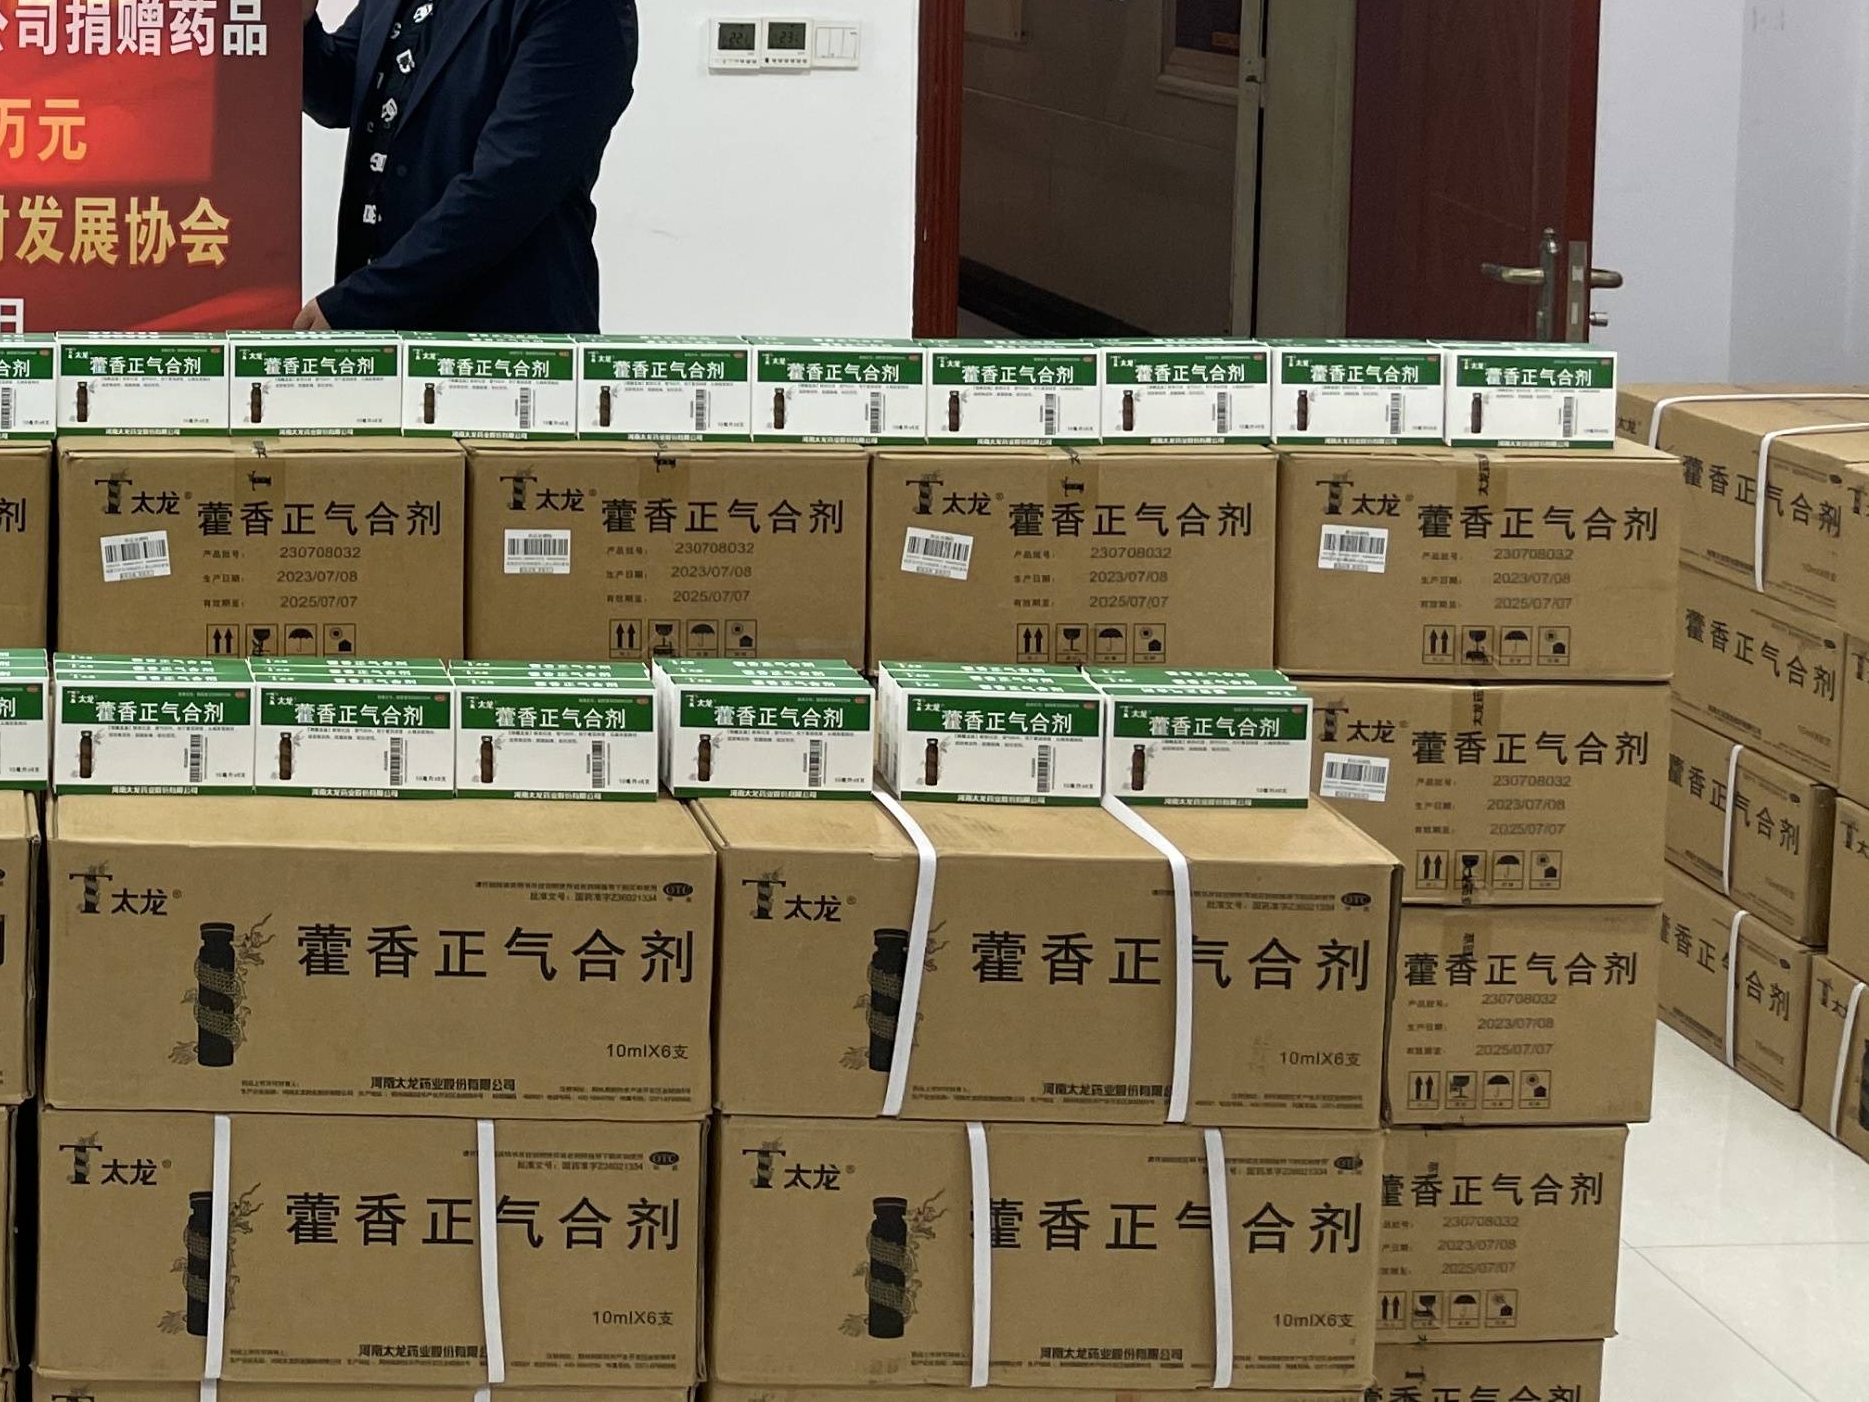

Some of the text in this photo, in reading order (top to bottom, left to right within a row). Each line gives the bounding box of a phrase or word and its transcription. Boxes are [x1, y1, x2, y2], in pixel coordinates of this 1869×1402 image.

[89, 356, 202, 375] 藿香正气合剂
[263, 356, 375, 376] 藿香正气合剂
[436, 358, 550, 378] 藿香正气合剂
[613, 360, 726, 380] 藿香正气合剂
[786, 362, 900, 383] 藿香正气合剂
[961, 365, 1075, 384] 藿香正气合剂
[1135, 363, 1246, 383] 藿香正气合剂
[1310, 365, 1419, 383] 藿香正气合剂
[1485, 367, 1593, 386] 藿香正气合剂
[198, 501, 440, 536] 藿香正气合剂
[602, 499, 843, 533] 藿香正气合剂
[1009, 502, 1251, 537] 藿香正气合剂
[1418, 506, 1657, 540] 藿香正气合剂
[280, 547, 360, 558] 230708032
[675, 543, 754, 553] 230708032
[1091, 547, 1171, 558] 230708032
[1494, 549, 1573, 560] 230708032
[277, 571, 357, 582] 2023/07/08
[671, 566, 751, 577] 2023/07/08
[1090, 571, 1167, 582] 2023/07/08
[1493, 573, 1570, 584] 2023/07/08
[281, 596, 357, 607] 2025/07/07
[674, 591, 749, 602] 2025/07/07
[1090, 596, 1167, 607] 2025/07/07
[1495, 598, 1571, 609] 2025/07/07
[1685, 608, 1836, 702] 藿香正气合剂
[95, 700, 225, 725] 藿香正气合剂
[294, 703, 424, 727] 藿香正气合剂
[495, 705, 626, 729] 藿香正气合剂
[714, 704, 845, 730] 藿香正气合剂
[941, 710, 1073, 734] 藿香正气合剂
[1148, 713, 1281, 738] 藿香正气合剂
[1412, 731, 1648, 765] 藿香正气合剂
[298, 924, 692, 983] 藿香正气合剂
[1405, 951, 1636, 986] 藿香正气合剂
[287, 1192, 678, 1250] 藿香正气合剂
